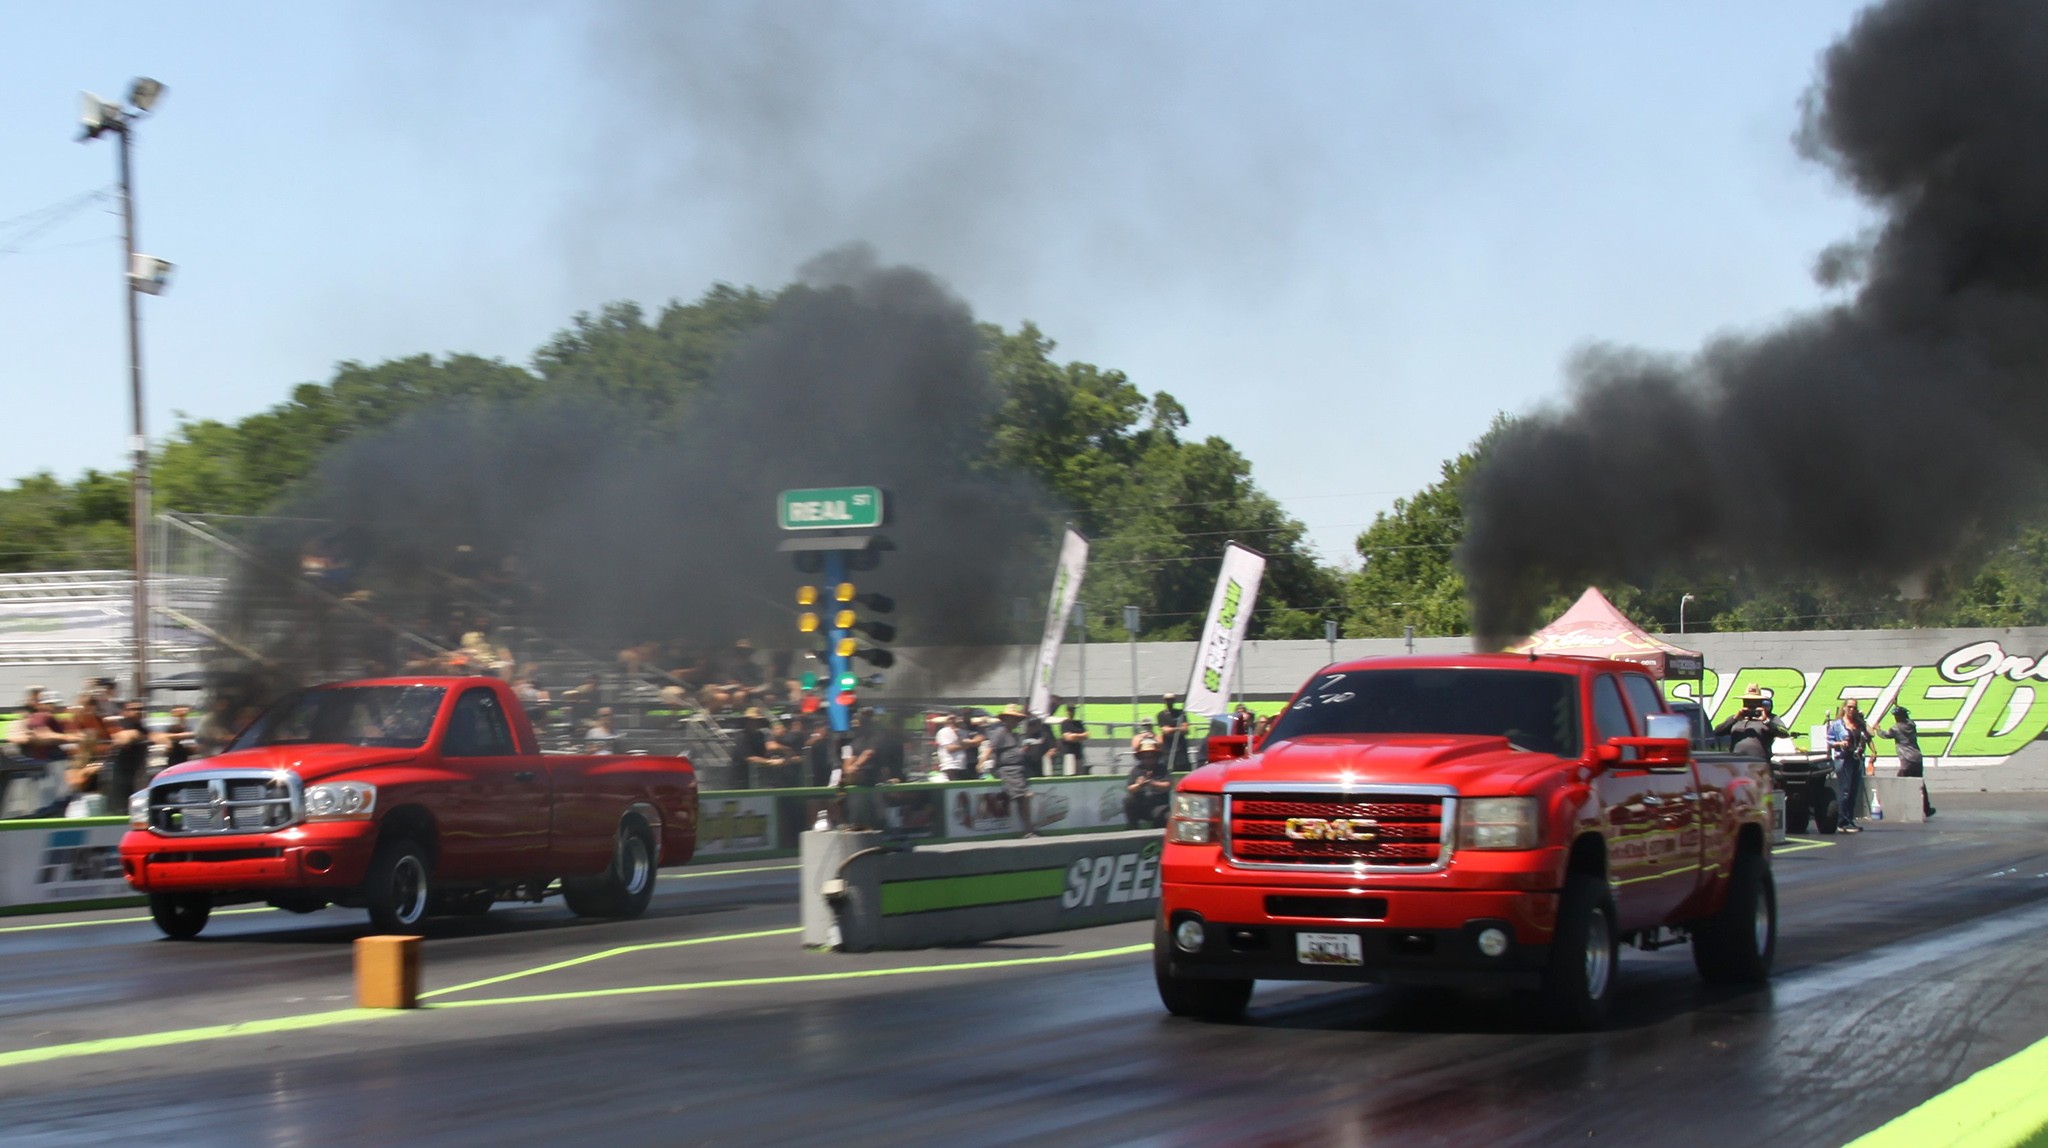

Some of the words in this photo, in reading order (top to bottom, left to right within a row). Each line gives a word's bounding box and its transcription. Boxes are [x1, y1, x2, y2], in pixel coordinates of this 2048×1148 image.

[788, 500, 853, 521] REAL
[852, 494, 872, 506] ST
[1285, 818, 1377, 840] GMC
[1062, 852, 1162, 909] SPEE
